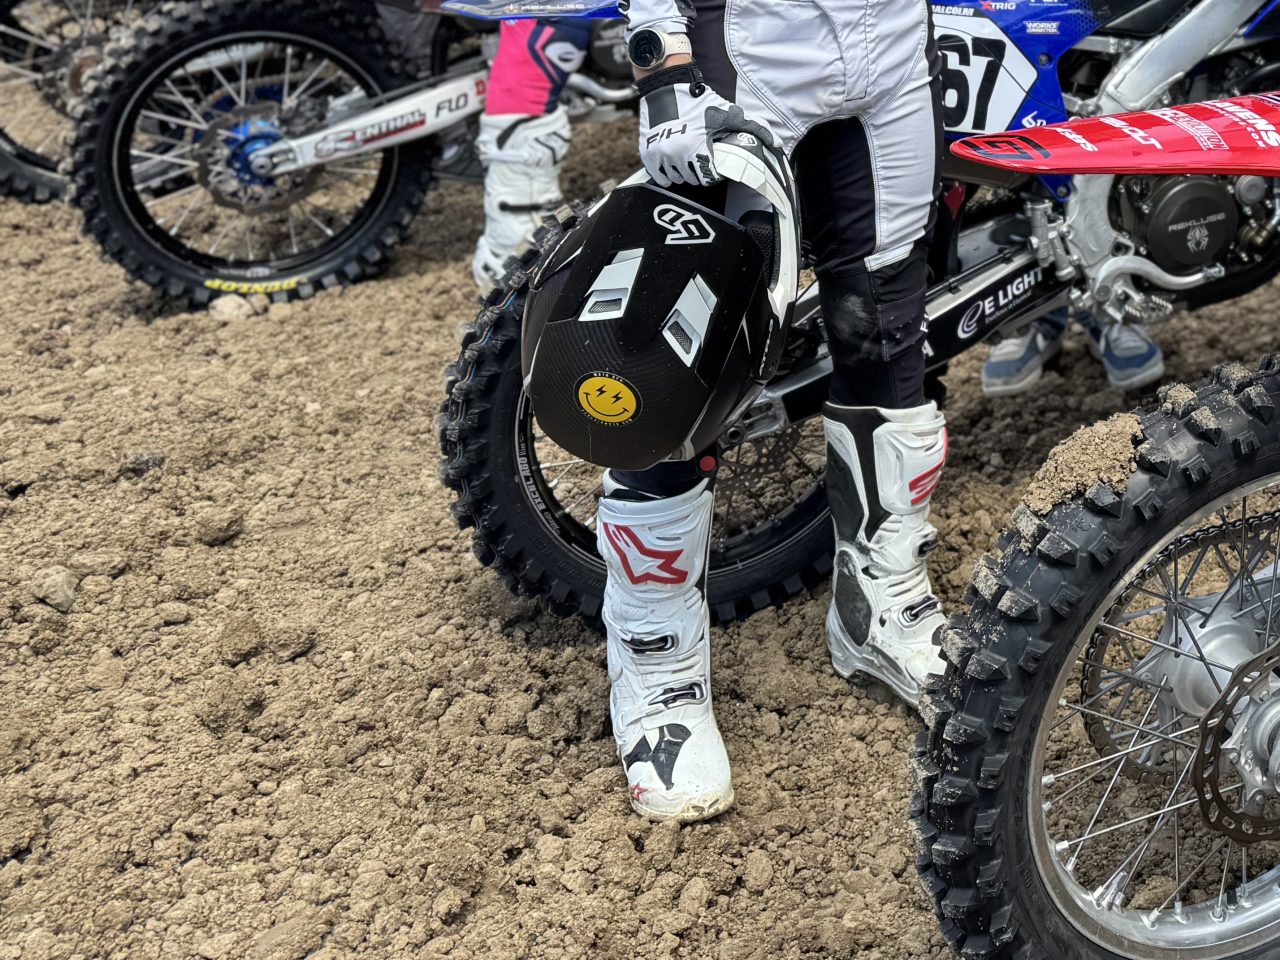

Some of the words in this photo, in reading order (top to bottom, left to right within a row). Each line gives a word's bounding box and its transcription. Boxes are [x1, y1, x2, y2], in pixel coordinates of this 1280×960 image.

[978, 0, 1017, 11] XTRIG
[937, 33, 1007, 132] 67
[983, 295, 996, 316] E
[998, 266, 1043, 307] LIGHT
